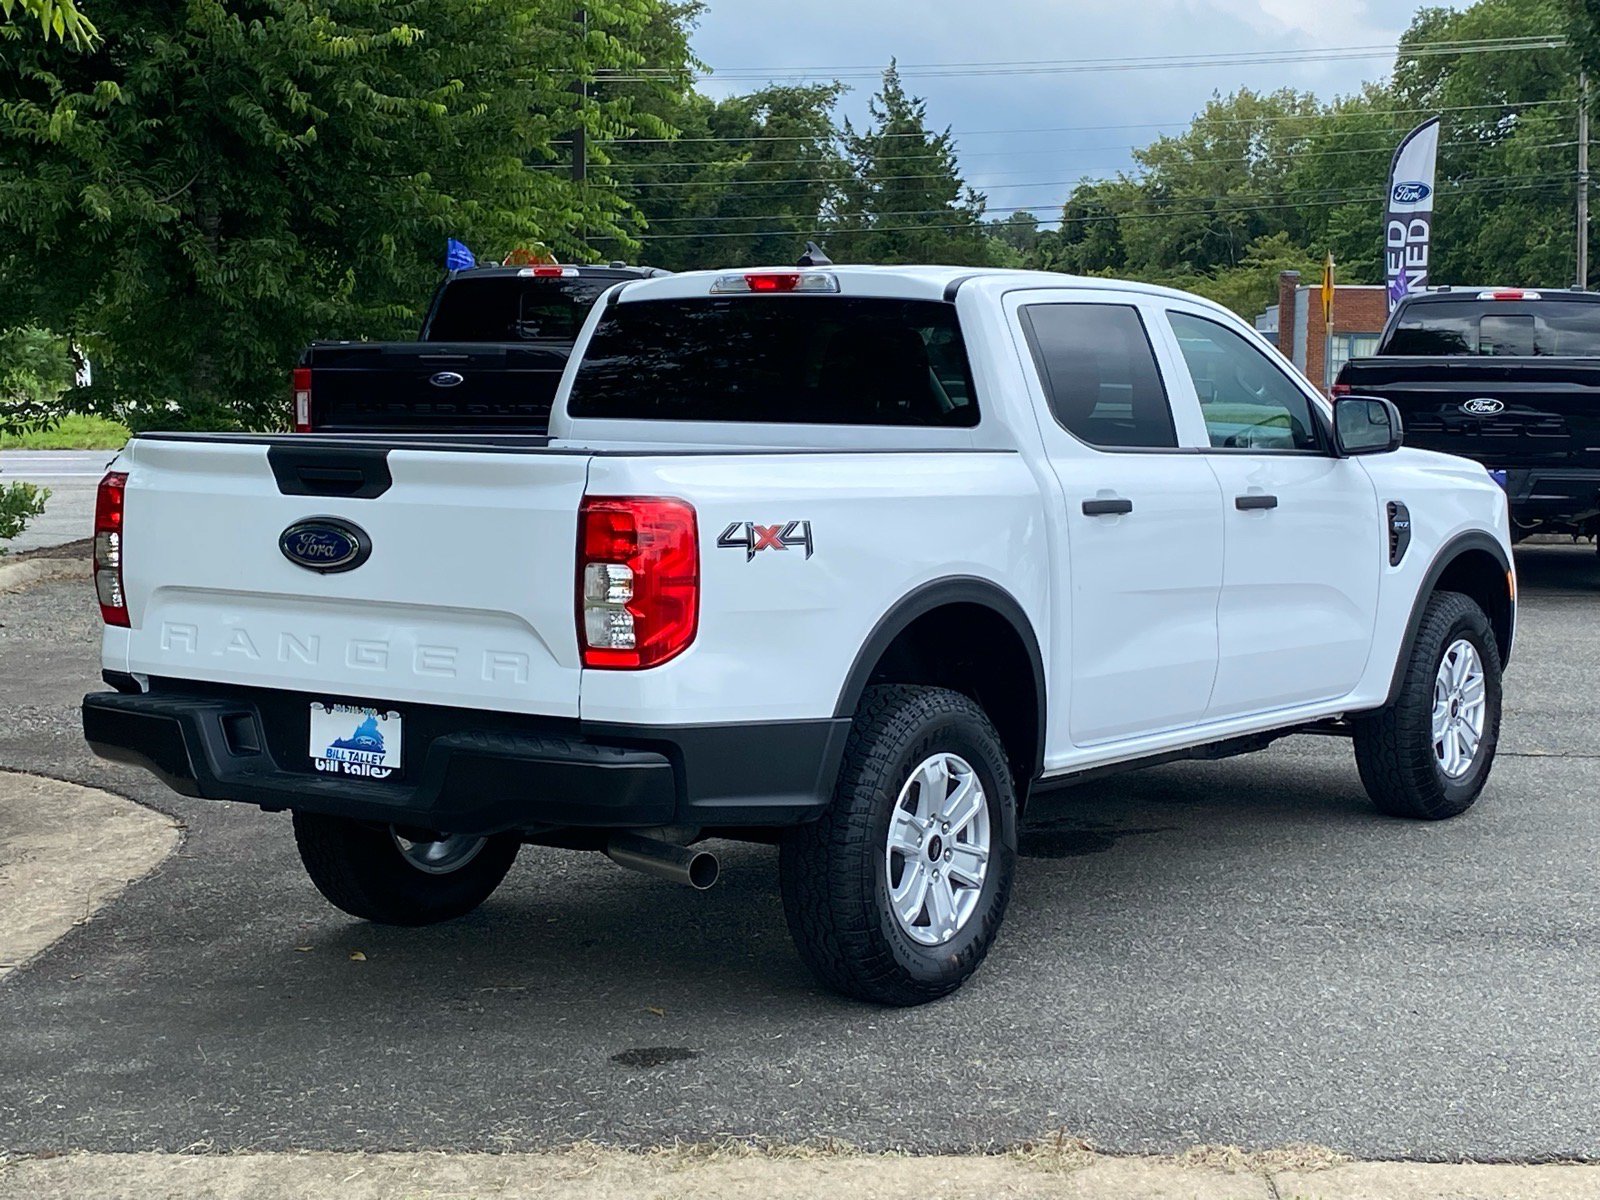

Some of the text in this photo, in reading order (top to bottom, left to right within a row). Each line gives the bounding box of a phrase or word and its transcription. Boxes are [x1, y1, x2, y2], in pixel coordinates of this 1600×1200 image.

[1394, 184, 1421, 200] Ford
[1405, 218, 1431, 293] NED
[1470, 400, 1497, 412] Ford
[296, 532, 338, 557] Ford
[160, 621, 530, 685] RANGER
[315, 758, 392, 778] bill talley
[348, 751, 385, 765] TALLEY
[977, 734, 1007, 785] TERRITORY
